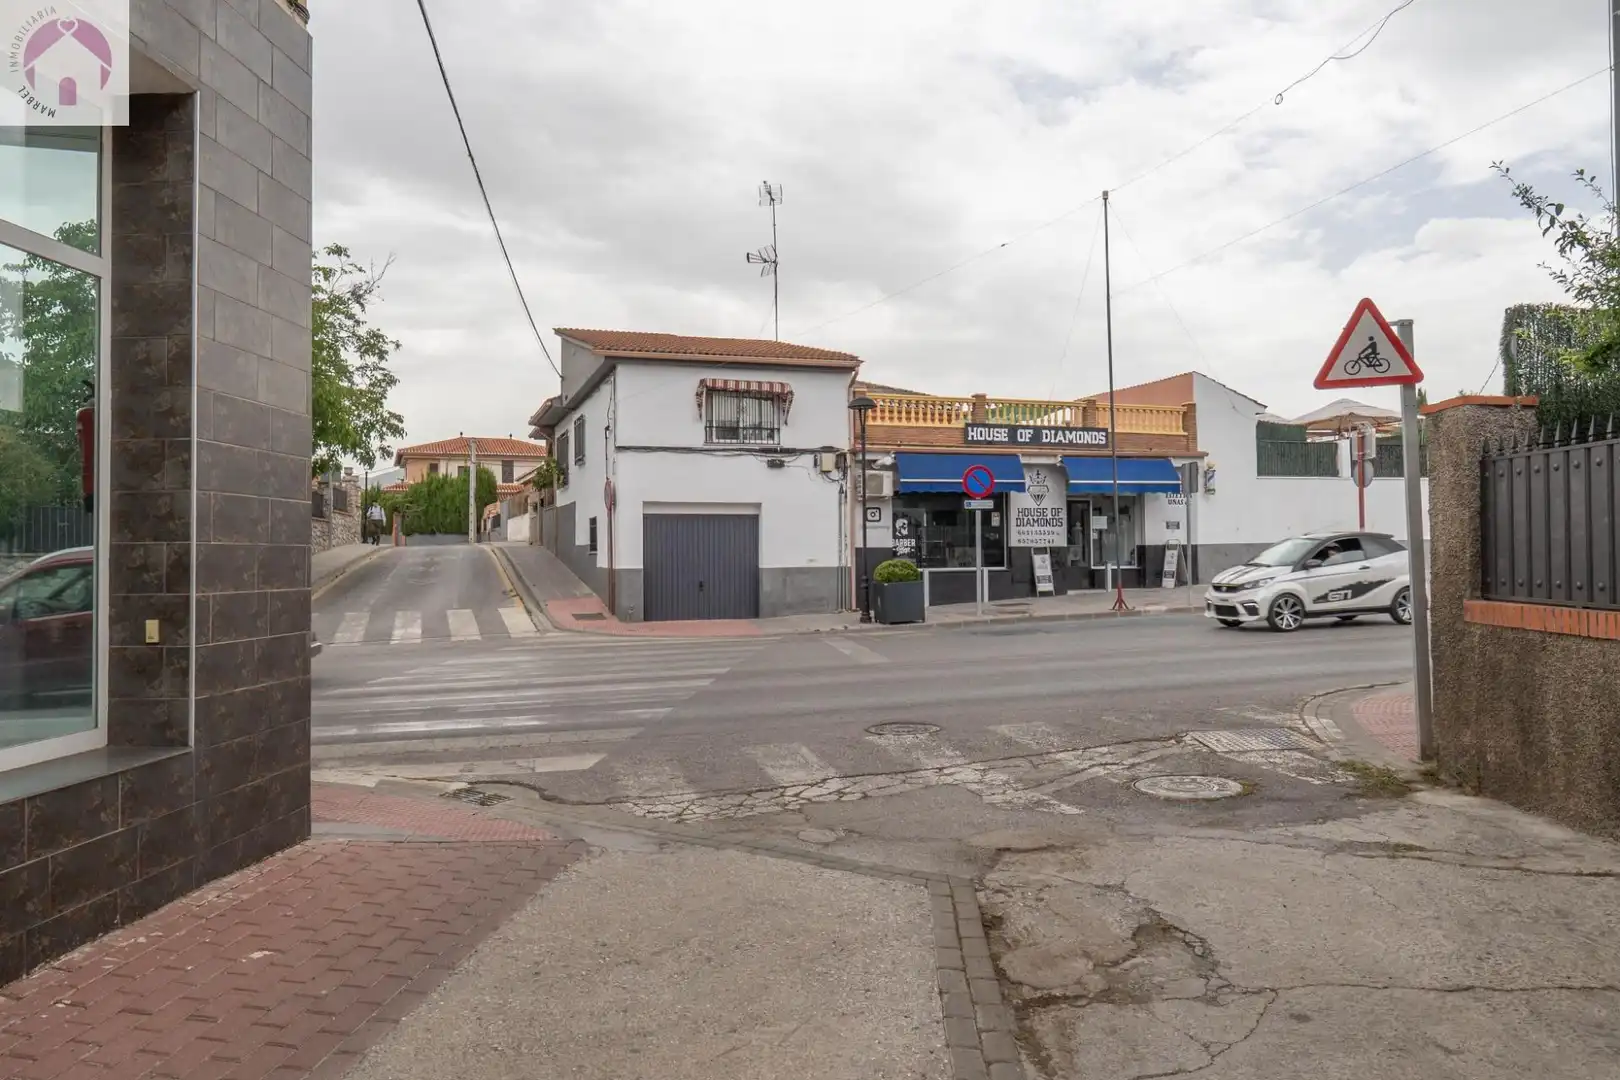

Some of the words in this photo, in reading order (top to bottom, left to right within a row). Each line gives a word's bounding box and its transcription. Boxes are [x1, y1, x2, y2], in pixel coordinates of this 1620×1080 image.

[967, 426, 1009, 442] HOUSE
[1016, 429, 1034, 442] OF
[1041, 429, 1106, 445] DIAMONDS
[1016, 507, 1048, 518] HOUSE
[1050, 507, 1064, 518] OF
[1015, 517, 1064, 528] DIAMONDS
